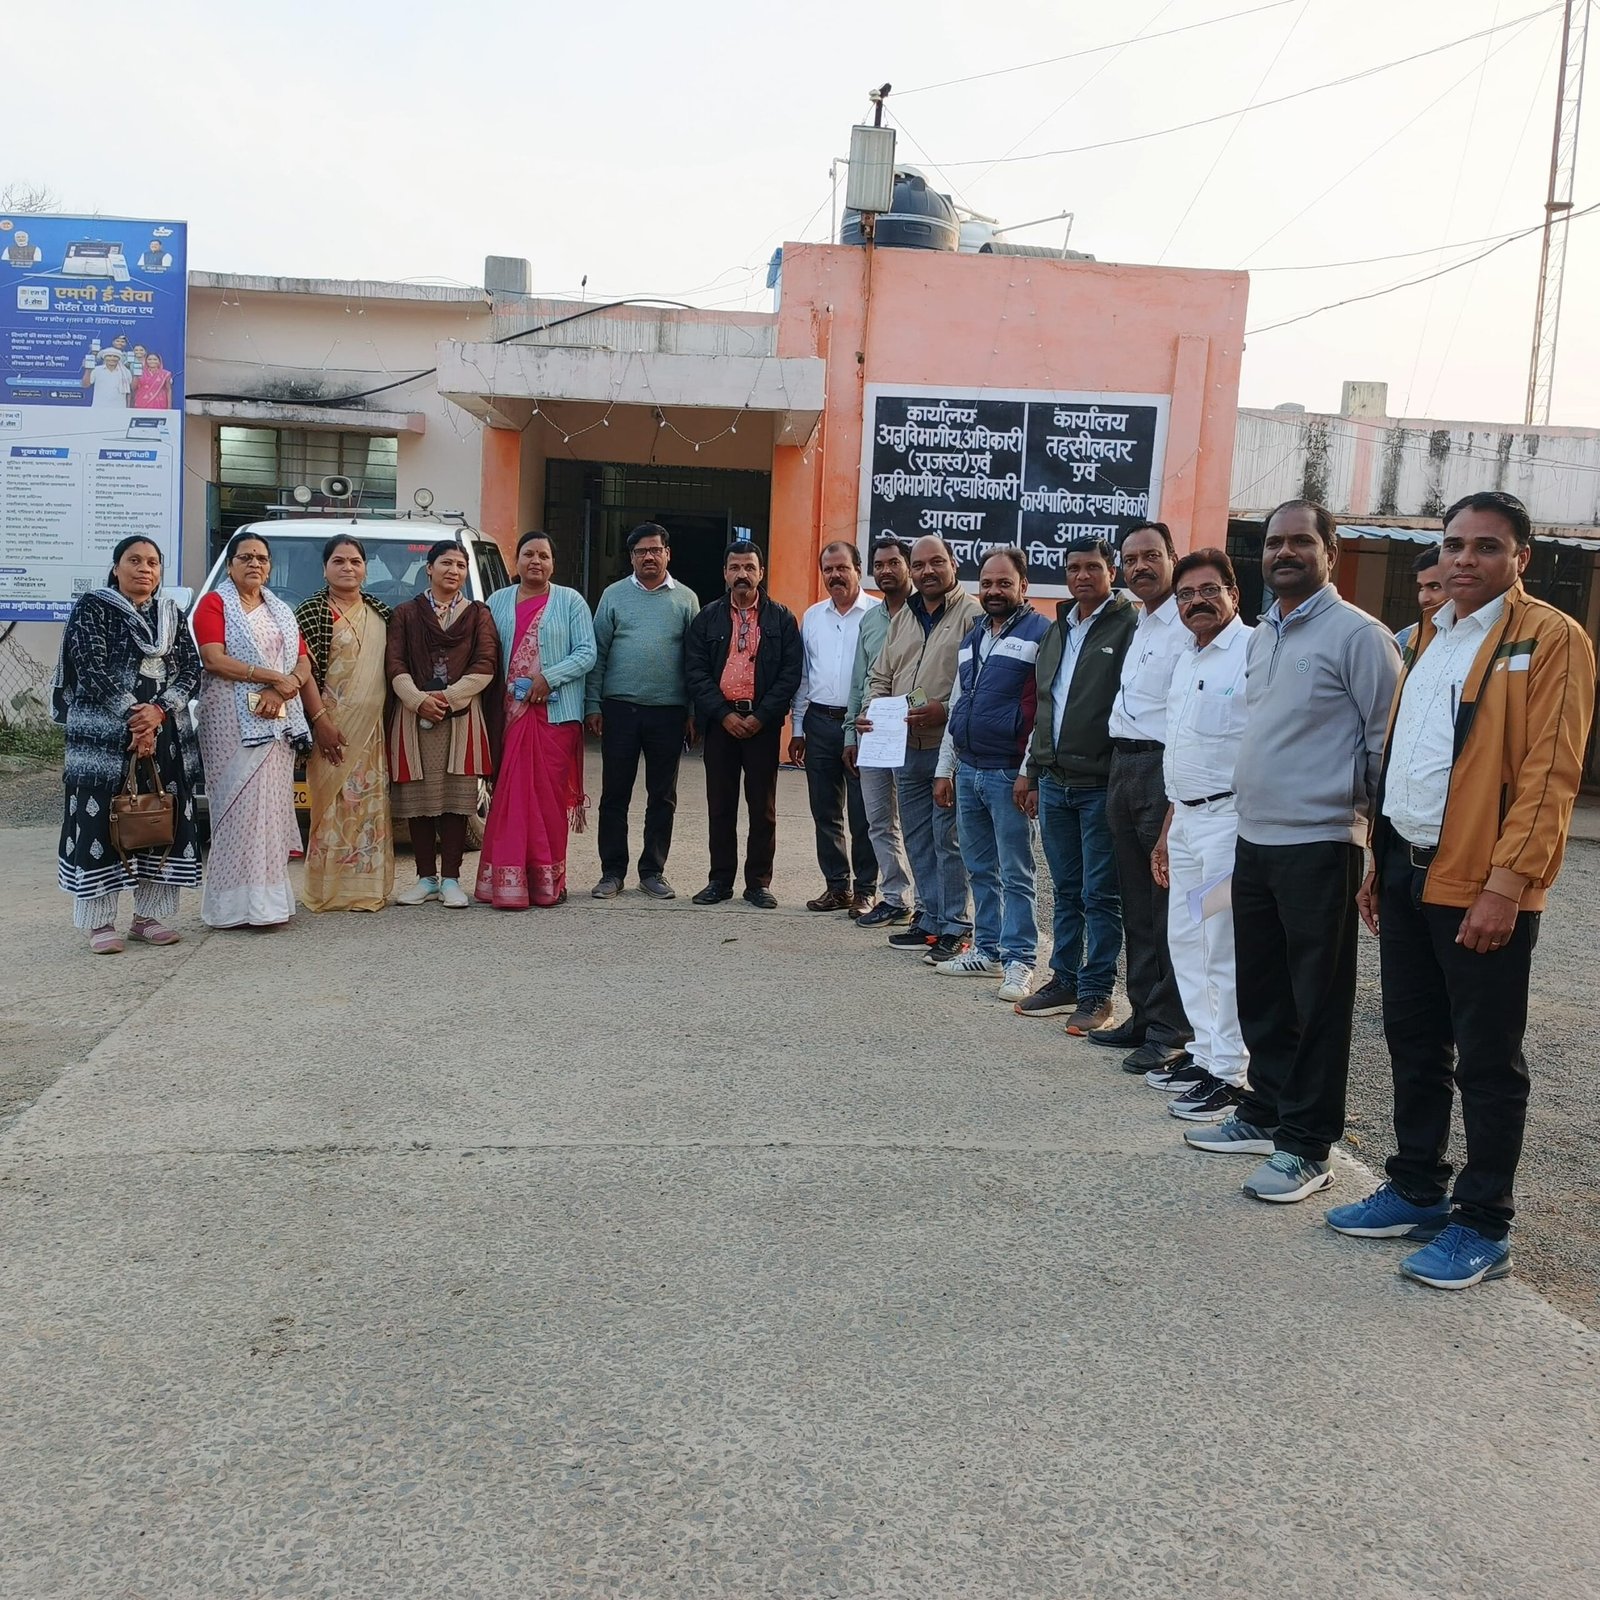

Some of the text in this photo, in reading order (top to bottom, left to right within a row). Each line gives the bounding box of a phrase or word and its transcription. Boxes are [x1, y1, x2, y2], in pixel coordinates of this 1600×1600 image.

[54, 285, 154, 302] एमपी ई-सेवा
[55, 302, 80, 312] पोर्टल
[100, 304, 136, 314] मोबाइल
[907, 400, 978, 425] कार्यालय
[1054, 406, 1129, 432] कार्यालय
[877, 421, 1023, 453] अनुविभागीय अधिकारी
[1046, 430, 1137, 462] तहसीलदार
[908, 449, 992, 474] (राजस्व) एवं
[1069, 459, 1101, 482] एवं
[872, 468, 1020, 502] अनुविभागीय दण्डाधिकारी
[1021, 486, 1149, 517] कार्यपालिक दण्डाधिकारी
[918, 510, 986, 531] आमला
[1054, 522, 1119, 543] आमला
